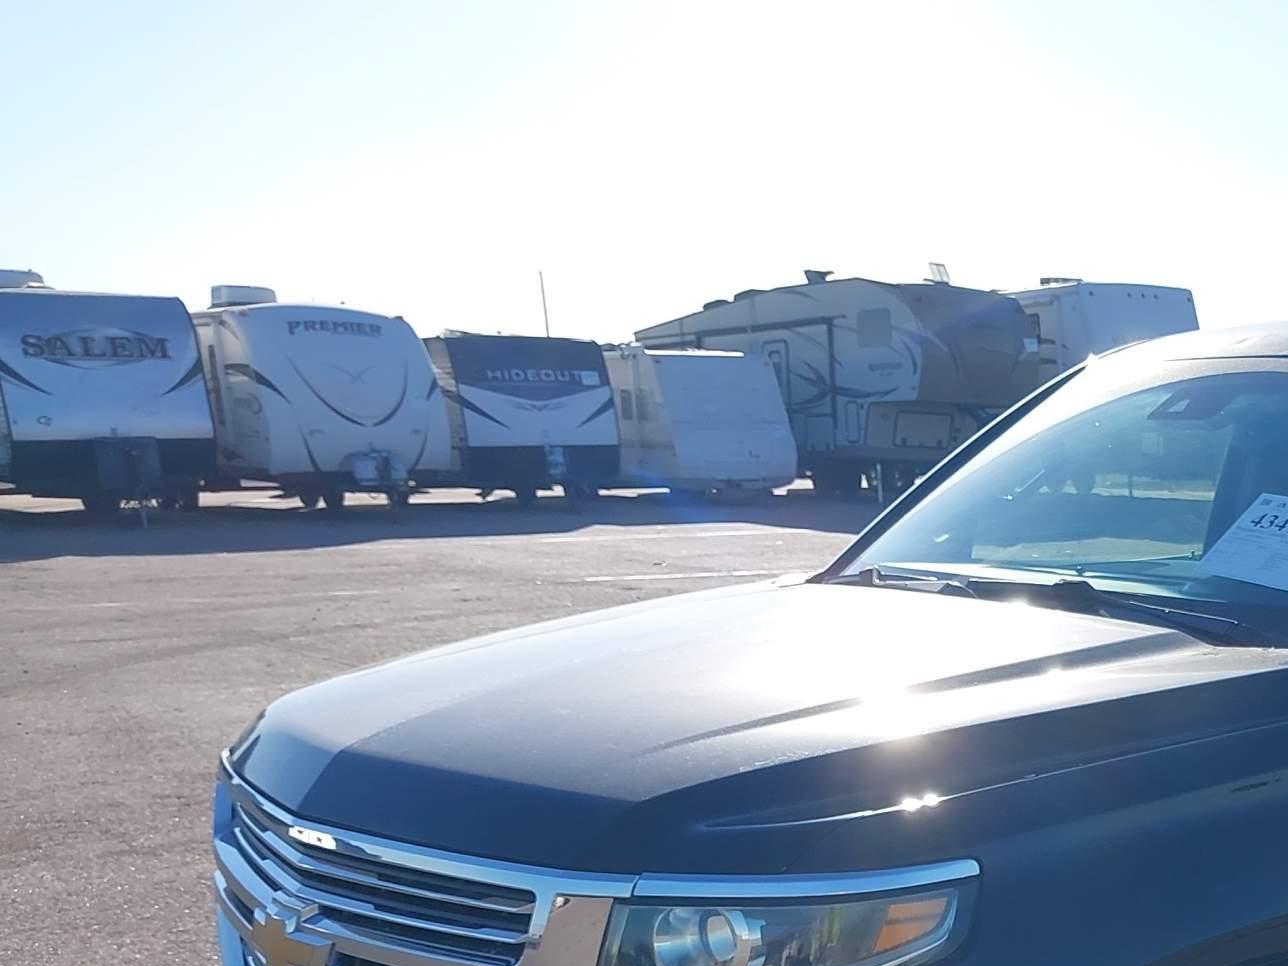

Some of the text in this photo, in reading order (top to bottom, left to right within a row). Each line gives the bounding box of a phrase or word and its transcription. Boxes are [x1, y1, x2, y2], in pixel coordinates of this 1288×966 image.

[287, 319, 383, 337] PREMIER
[20, 334, 171, 359] SALEM
[486, 369, 583, 382] HIDEOUT
